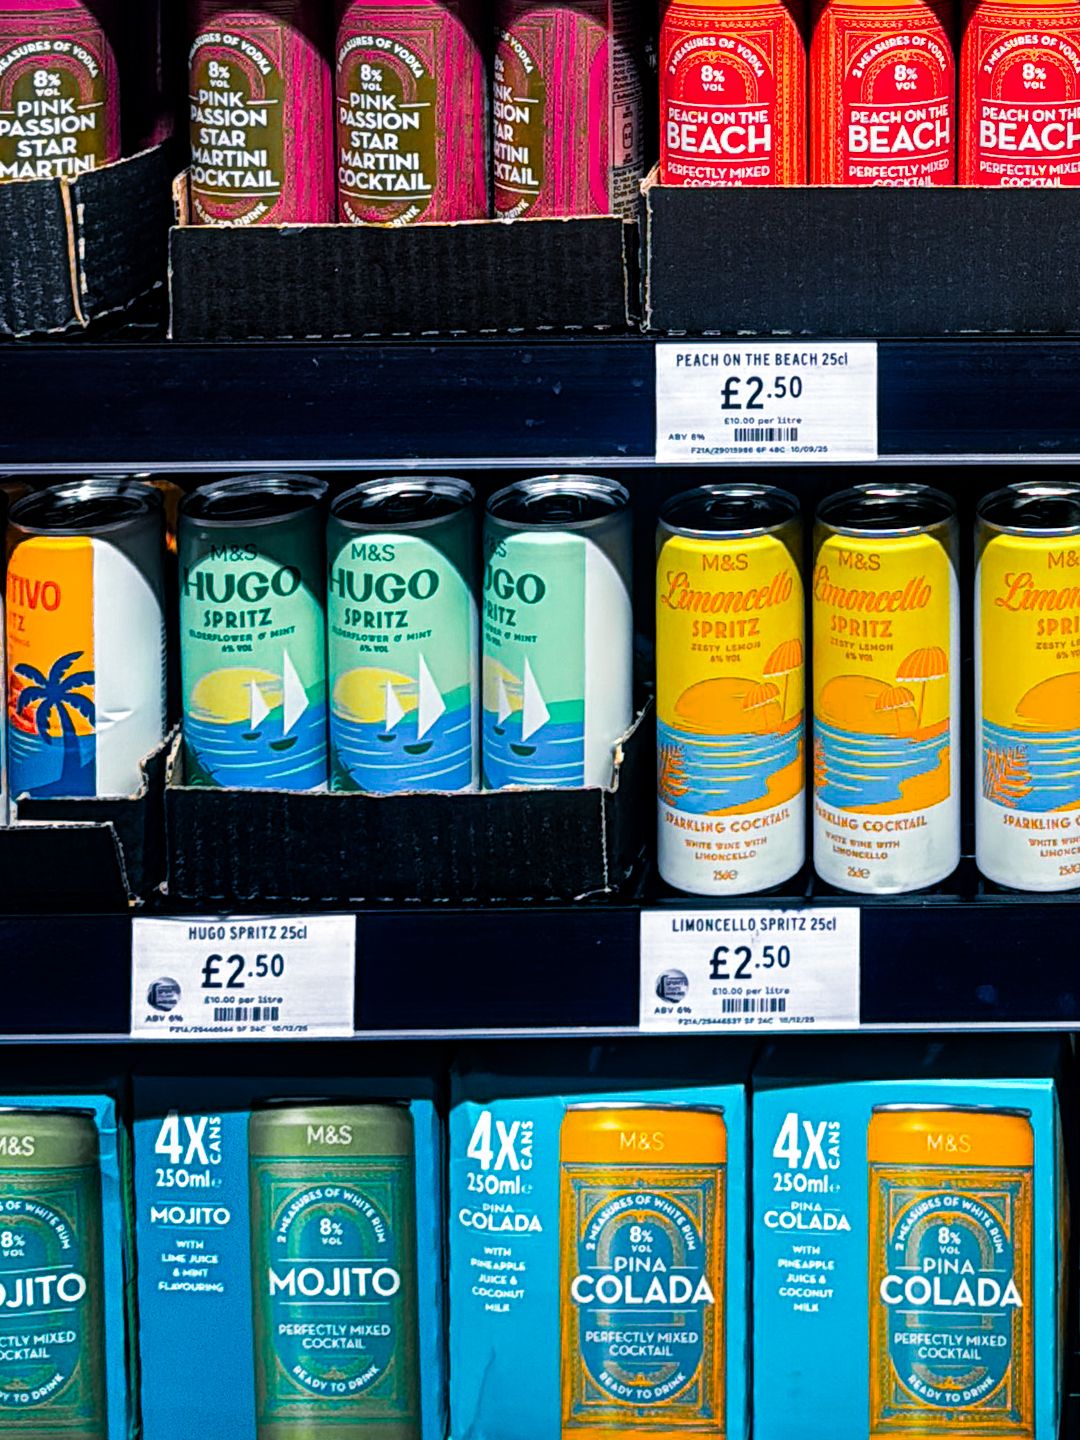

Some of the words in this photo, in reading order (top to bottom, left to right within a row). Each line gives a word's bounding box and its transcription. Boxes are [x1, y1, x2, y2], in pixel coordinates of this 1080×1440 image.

[350, 92, 395, 110] PINK
[340, 111, 419, 129] PASSION
[667, 109, 707, 124] PEACH
[711, 110, 735, 124] ON
[738, 109, 768, 123] THE
[350, 131, 399, 148] STAR
[666, 125, 771, 152] BEACH
[341, 151, 419, 169] MARTINI
[339, 170, 431, 190] COCKTAIL
[676, 354, 718, 367] PEACH
[723, 354, 741, 366] ON
[746, 354, 770, 365] THE
[775, 353, 817, 365] BEACH
[822, 352, 847, 365] 25cl
[721, 376, 802, 409] £2.50
[185, 570, 301, 603] HUGO
[661, 569, 793, 614] Limoncello
[203, 607, 272, 628] SPRITZ
[692, 618, 760, 638] SPRITZ
[189, 927, 225, 940] HUGO
[230, 926, 276, 939] SPRITZ
[280, 926, 307, 939] 25cl
[672, 919, 755, 932] LIMONCELLO
[760, 918, 805, 930] SPRITZ
[811, 918, 836, 930] 25cl
[201, 954, 284, 988] £2.50
[709, 945, 790, 979] £2.50
[155, 1111, 209, 1165] 4X
[209, 1116, 221, 1164] CANS
[150, 1206, 230, 1225] MOJITO
[176, 1240, 204, 1249] WITH
[161, 1254, 186, 1263] LIME
[189, 1254, 218, 1263] JUICE
[269, 1267, 400, 1296] MOJITO
